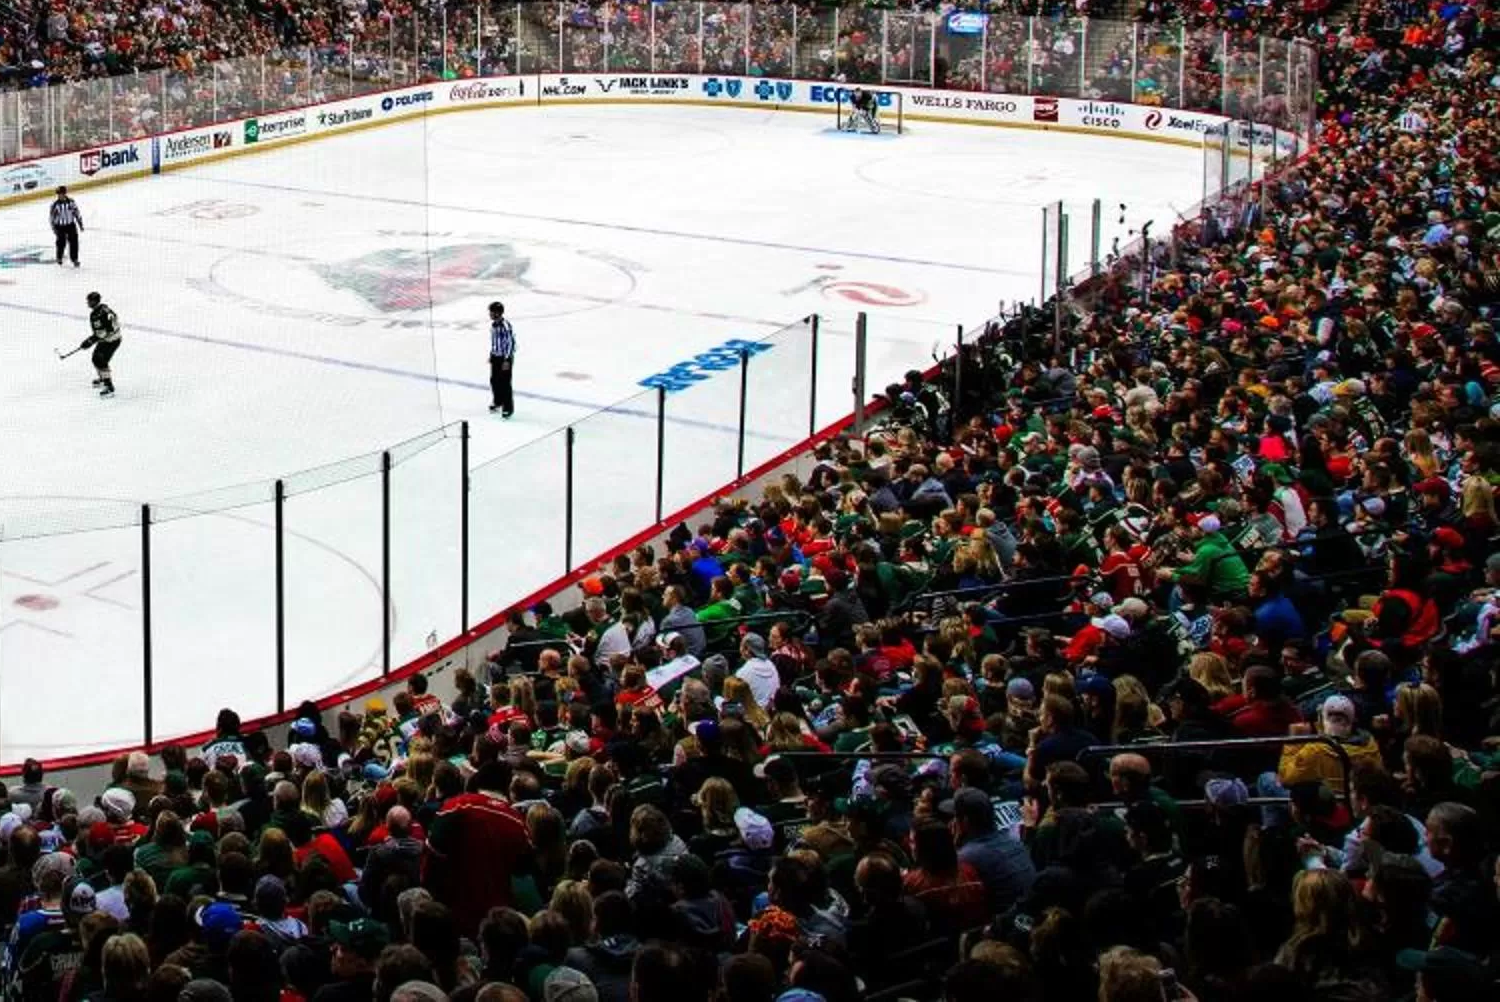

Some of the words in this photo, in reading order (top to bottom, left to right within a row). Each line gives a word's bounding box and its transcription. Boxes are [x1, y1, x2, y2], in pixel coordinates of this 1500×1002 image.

[810, 85, 892, 107] ECOB
[911, 95, 963, 110] WELLS
[966, 98, 1017, 113] FARGO
[1082, 116, 1121, 129] CISCO
